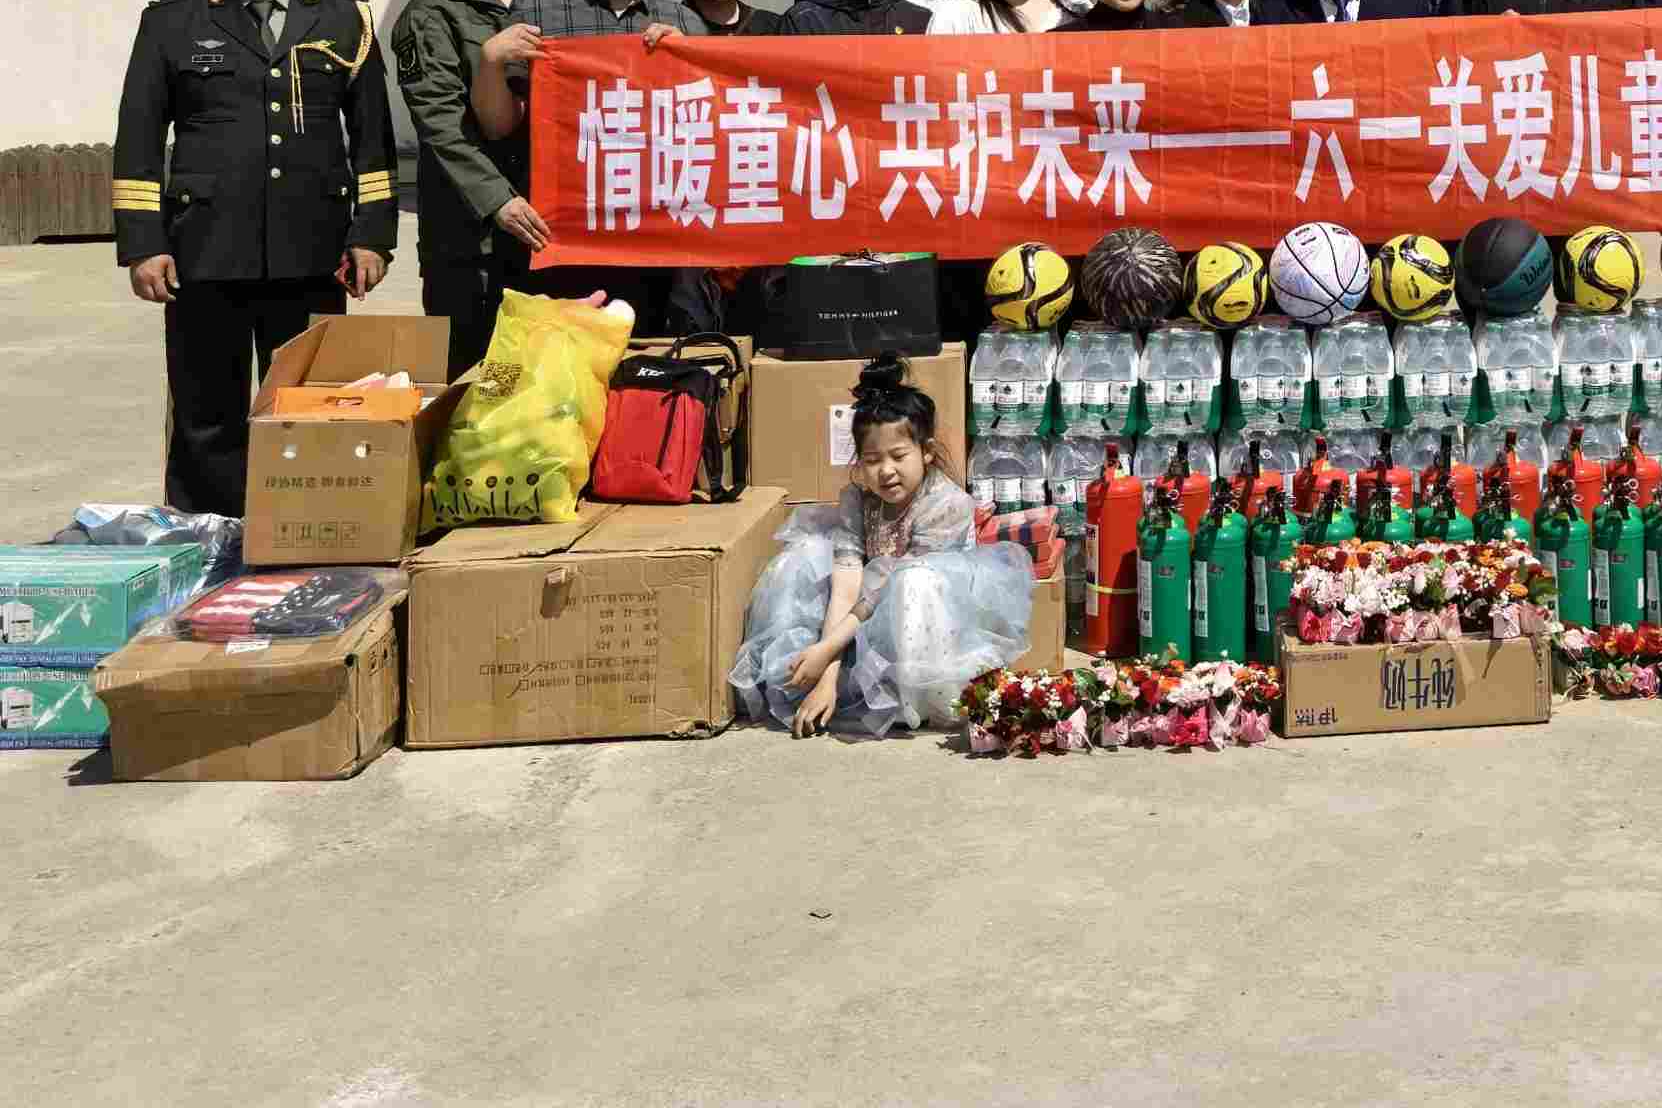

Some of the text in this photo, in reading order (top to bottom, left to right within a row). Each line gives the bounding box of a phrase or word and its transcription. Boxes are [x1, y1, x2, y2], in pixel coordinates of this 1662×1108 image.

[576, 75, 860, 232] 情暖童心
[1382, 657, 1456, 711] 纯牛奶
